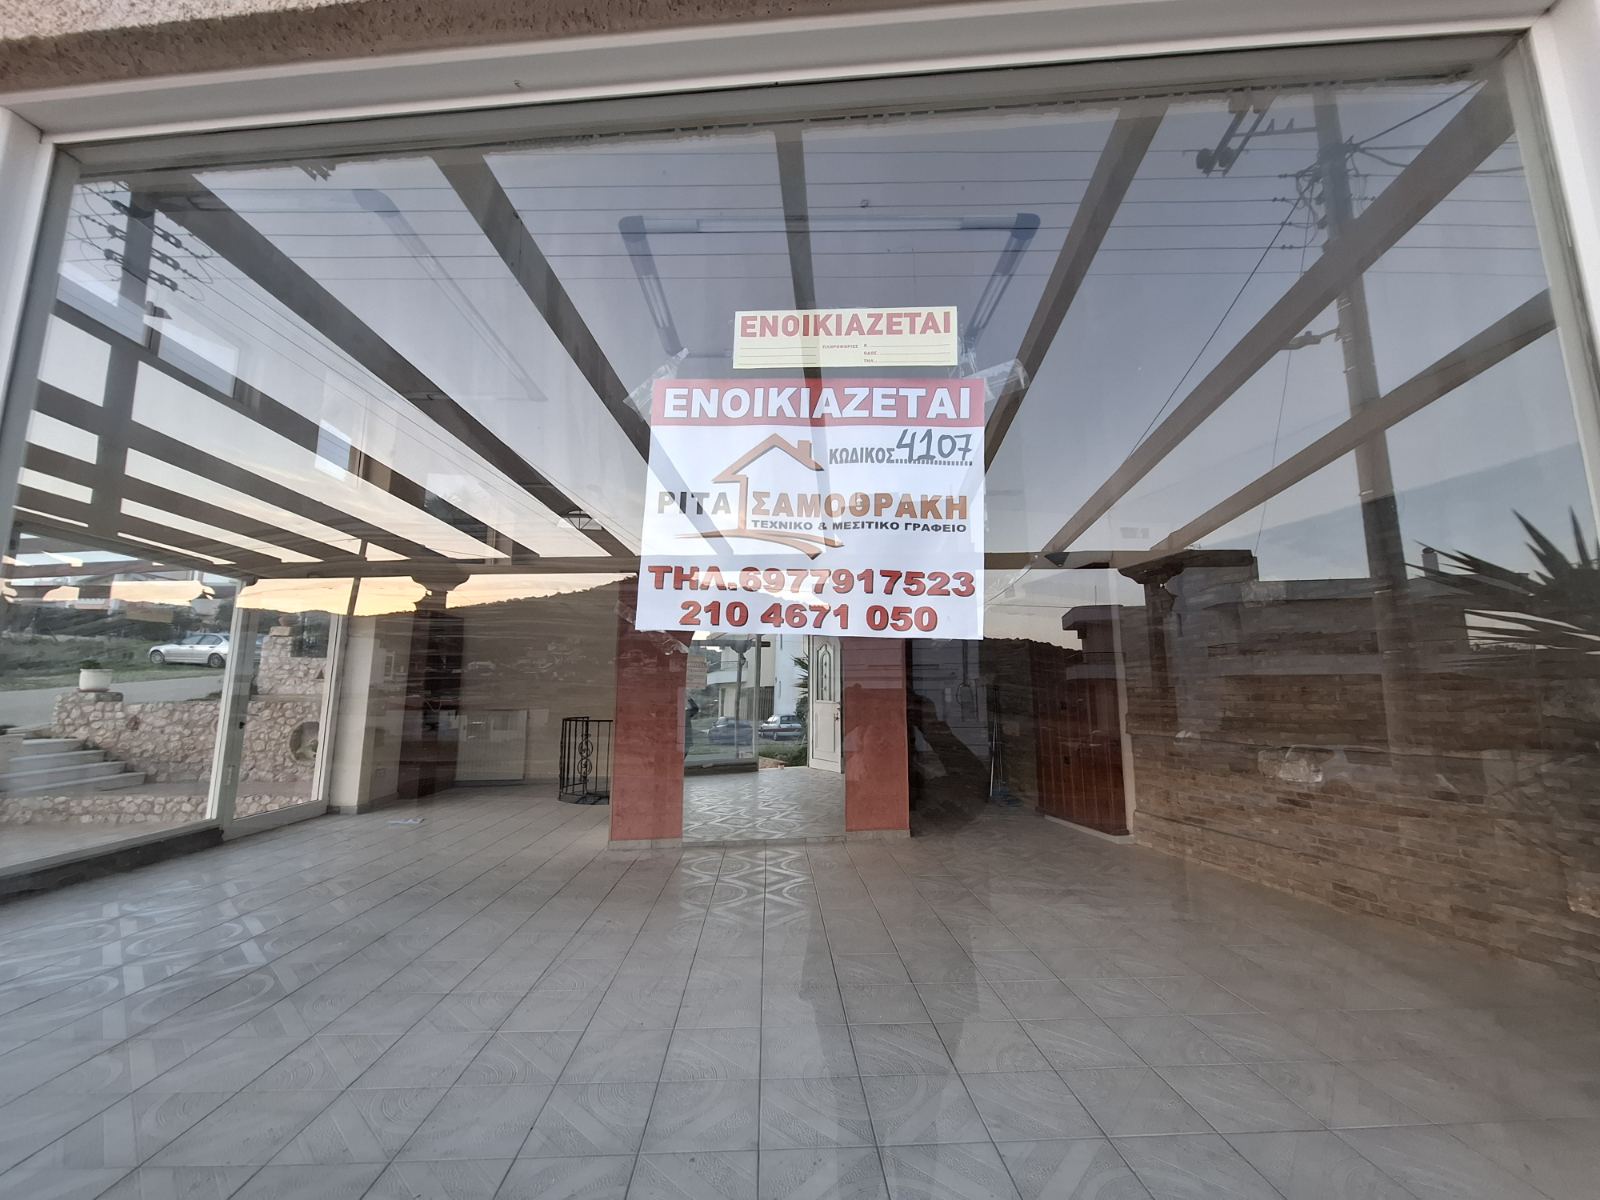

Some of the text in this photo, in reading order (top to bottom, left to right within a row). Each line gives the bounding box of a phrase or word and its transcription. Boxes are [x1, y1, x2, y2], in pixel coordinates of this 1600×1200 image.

[740, 311, 951, 338] ΕΝΟΙΚΙΑΖΕΤΑΙ
[663, 387, 971, 419] ΕΝΟΙΚΙΑΖΕΤΑΙ
[896, 428, 972, 462] 4107
[657, 490, 968, 520] ΡΙΤΑ ΣΑΜΟΘΡΑΚΗ
[751, 519, 967, 533] ΤΕΧΝΙΚΟ & ΜΕΣΙΤΙΚΟ ΓΡΑΦΕΙΟ
[678, 600, 938, 632] 210 4671 050
